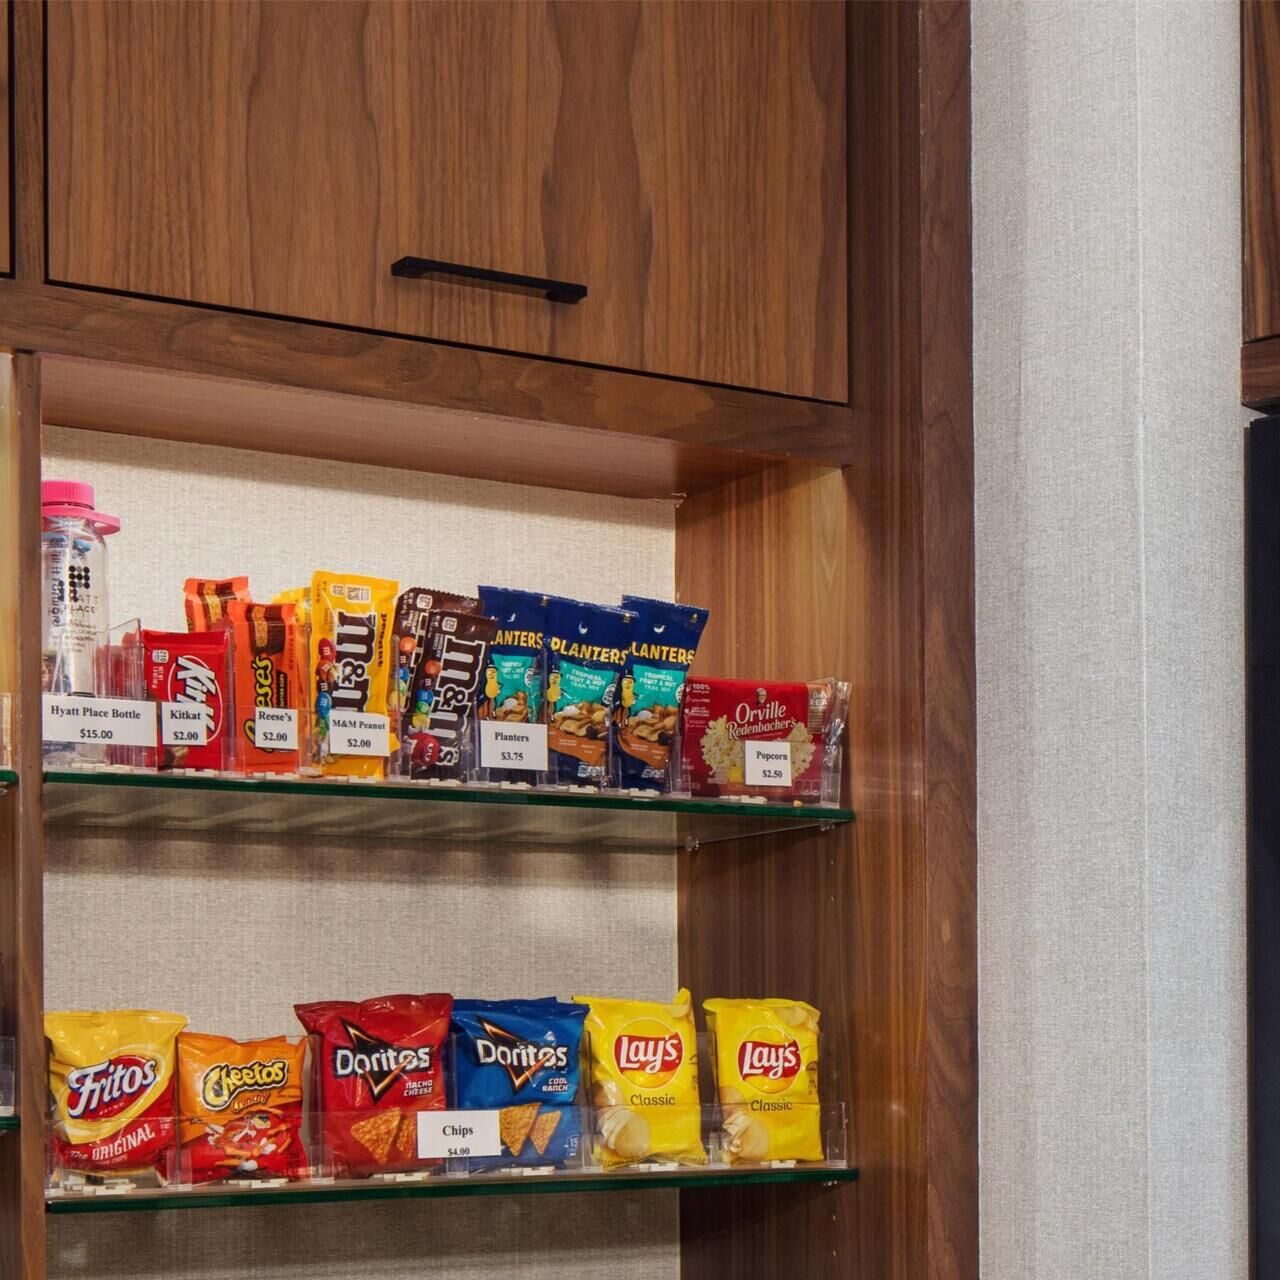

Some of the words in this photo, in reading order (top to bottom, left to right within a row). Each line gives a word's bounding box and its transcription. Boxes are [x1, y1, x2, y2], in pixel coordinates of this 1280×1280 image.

[550, 637, 628, 666] PLANTERS
[50, 706, 79, 718] Hyatt
[82, 708, 109, 718] Place
[112, 709, 141, 720] Bottle
[170, 710, 200, 720] Kitkat
[736, 701, 786, 724] Orville
[332, 720, 356, 730] M&M
[358, 721, 385, 730] Peanut
[727, 717, 797, 740] Redenbacher's
[80, 728, 113, 739] $15.00
[173, 731, 198, 741] $2.00
[495, 732, 529, 742] Planters
[501, 752, 523, 761] $3.75
[756, 751, 788, 762] Popcorn
[762, 770, 782, 778] $2.50
[620, 1031, 679, 1074] Lay's
[336, 1046, 431, 1075] Doritos
[68, 1058, 157, 1118] Fritos
[203, 1060, 286, 1109] Cheetos
[404, 1087, 432, 1096] CHEESE
[630, 1095, 676, 1106] Classic
[442, 1125, 474, 1137] Chips
[91, 1123, 156, 1160] ORIGINAL
[448, 1147, 470, 1156] $4.00
